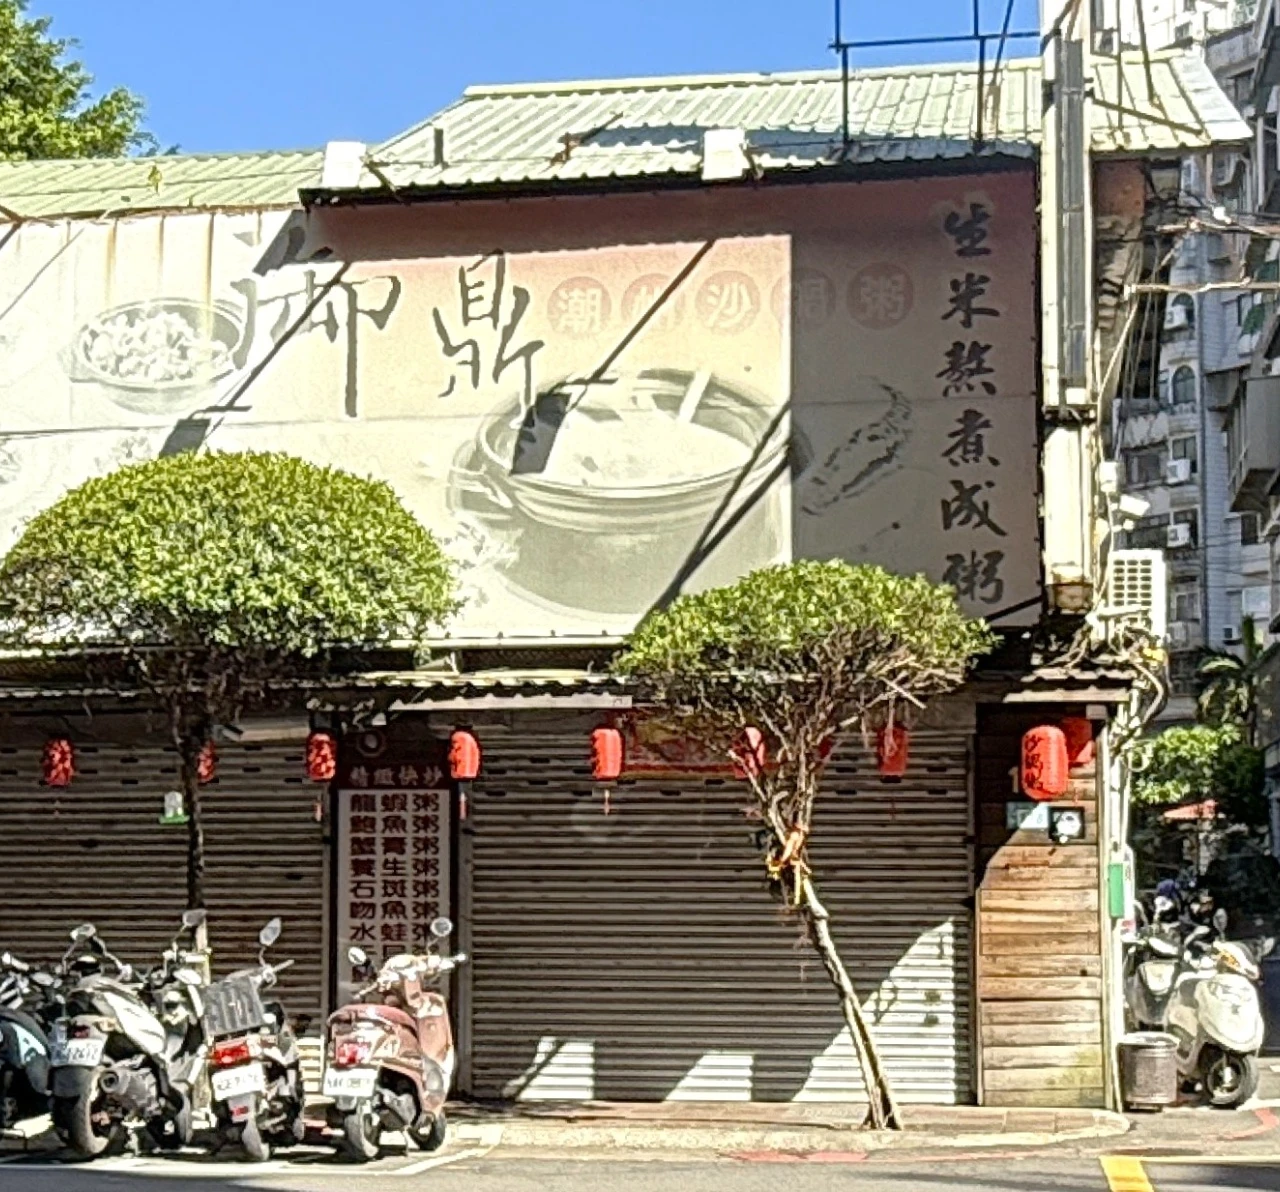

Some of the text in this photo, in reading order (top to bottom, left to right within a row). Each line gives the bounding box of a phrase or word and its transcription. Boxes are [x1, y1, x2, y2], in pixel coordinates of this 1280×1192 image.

[934, 202, 1009, 604] 生米熬煮成粥
[349, 793, 441, 813] 龍蝦粥
[349, 815, 441, 834] 鮑魚粥
[349, 858, 441, 878] 養生粥
[349, 879, 441, 899] 石斑粥
[349, 901, 441, 920] 吻魚粥
